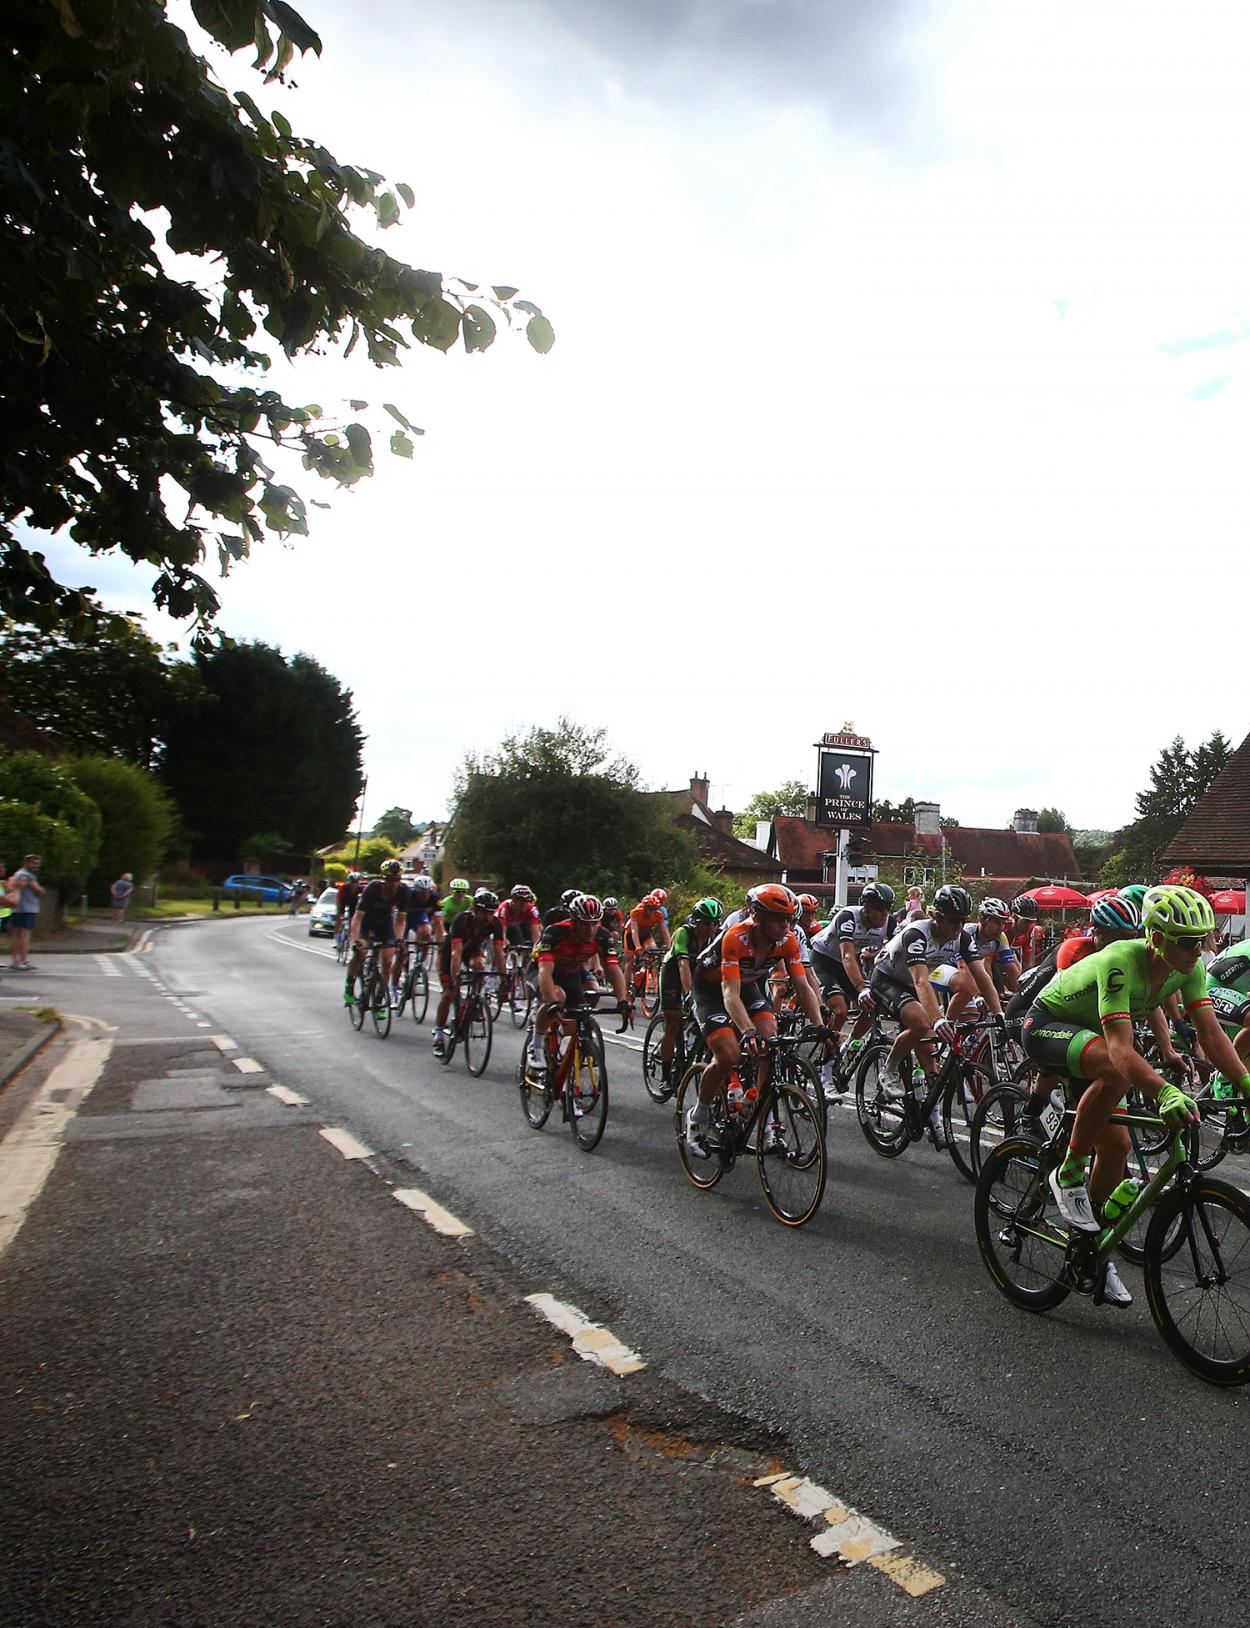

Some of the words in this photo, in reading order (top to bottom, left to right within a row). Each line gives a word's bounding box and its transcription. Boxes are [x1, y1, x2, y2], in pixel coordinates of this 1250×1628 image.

[828, 736, 867, 747] FULLER'S
[825, 798, 865, 809] PRINCE
[827, 811, 862, 821] WALES
[1045, 1111, 1059, 1131] 93
